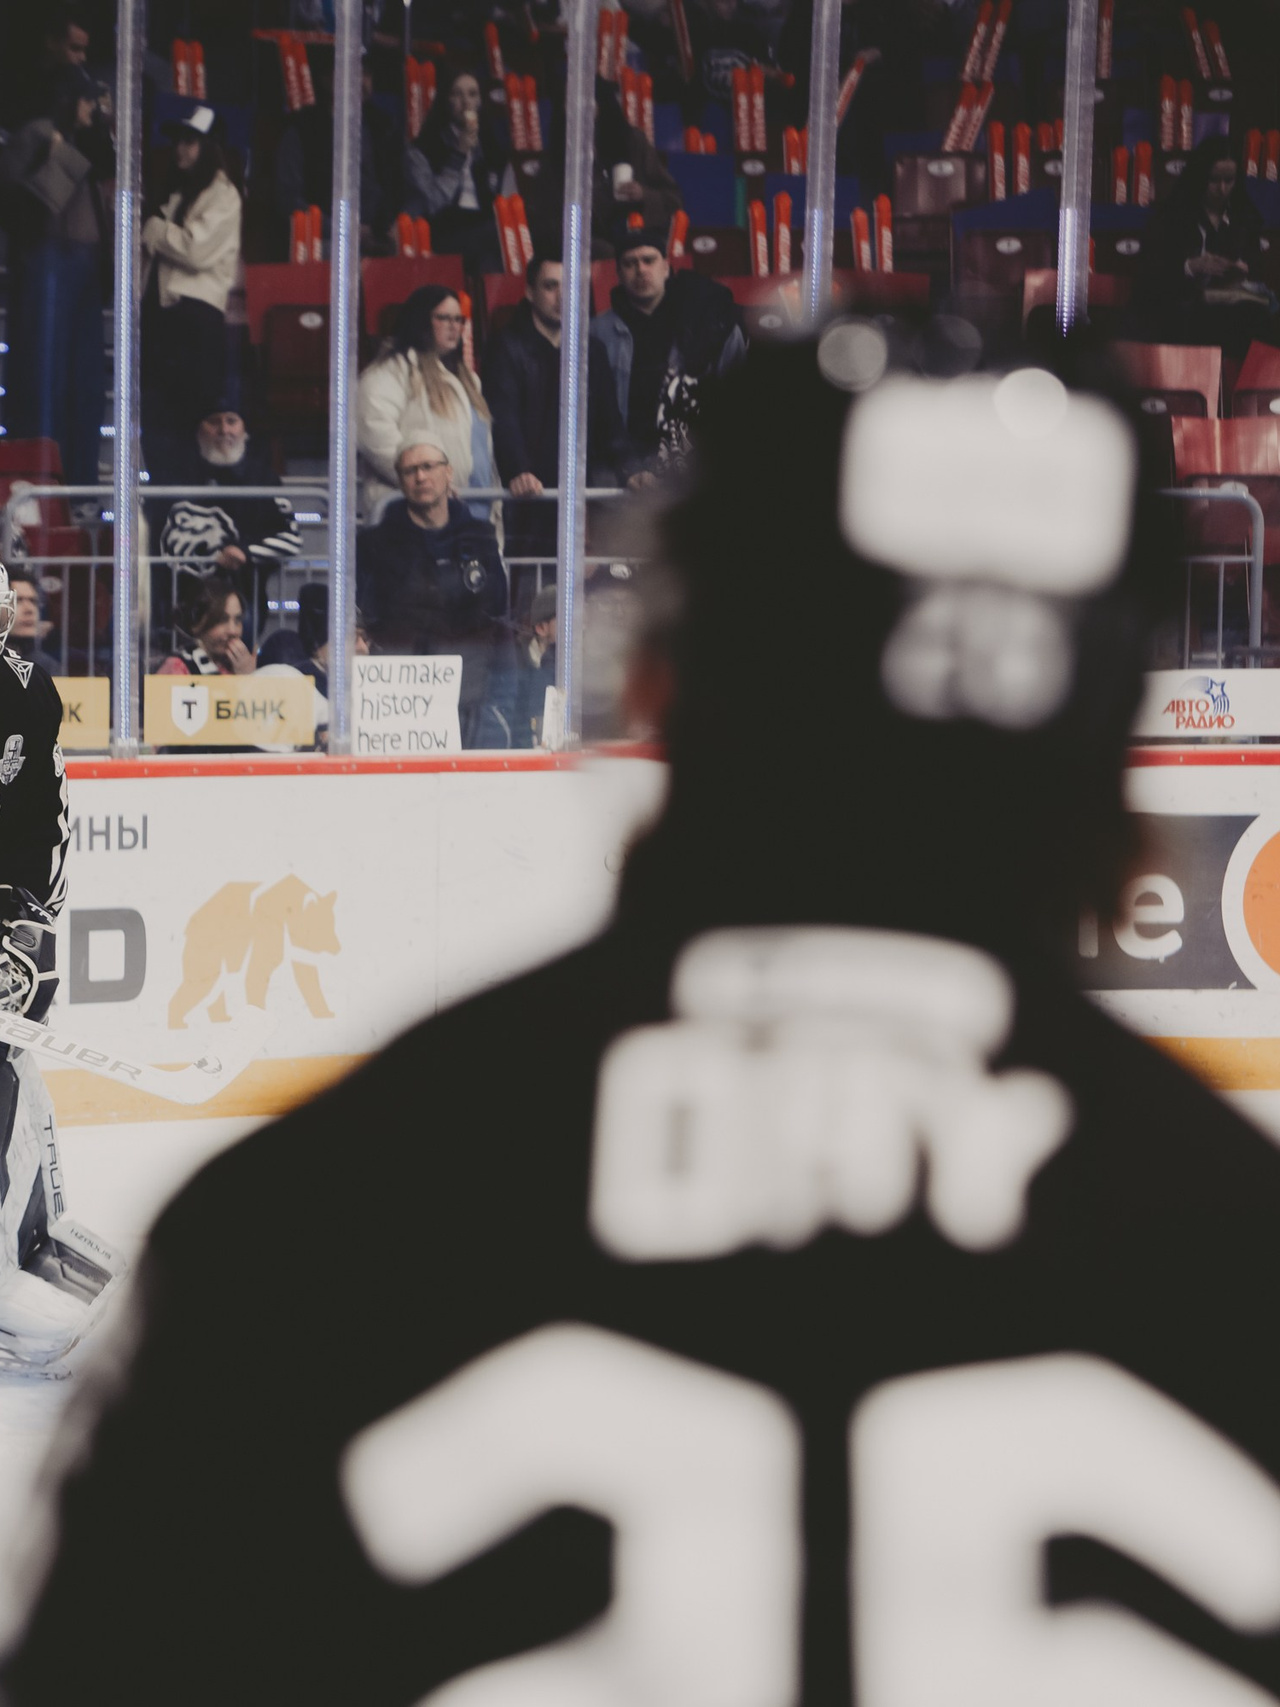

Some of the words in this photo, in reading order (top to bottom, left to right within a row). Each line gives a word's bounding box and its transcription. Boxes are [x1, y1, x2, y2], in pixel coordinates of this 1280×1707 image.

[358, 663, 393, 688] you
[399, 661, 455, 685] make
[215, 699, 286, 720] БАНК
[361, 692, 433, 720] history
[1163, 699, 1210, 714] АВТО
[1176, 714, 1236, 730] РАДИО
[358, 727, 402, 753] here
[408, 730, 448, 751] now
[44, 1113, 65, 1220] TRUE
